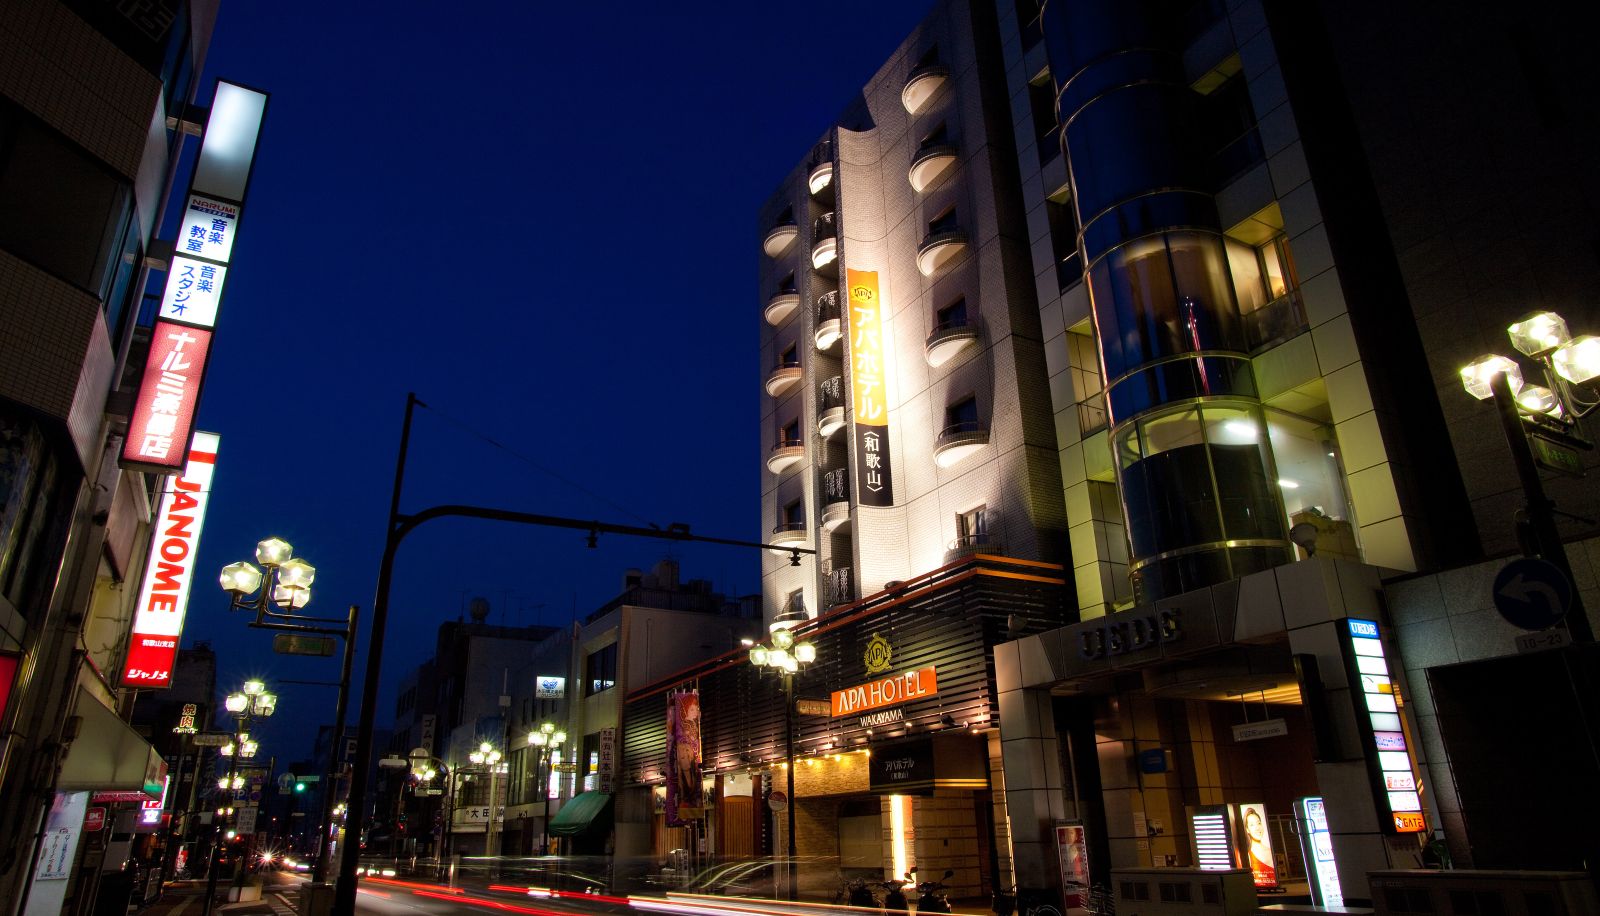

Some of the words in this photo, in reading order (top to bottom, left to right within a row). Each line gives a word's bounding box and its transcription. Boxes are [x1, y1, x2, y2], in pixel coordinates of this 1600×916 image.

[191, 199, 236, 214] NARUMI
[186, 225, 207, 253] 教室
[207, 218, 228, 245] 音楽
[171, 265, 195, 316] スタジオ
[197, 265, 216, 293] 音楽
[853, 307, 882, 420] アパホテル
[147, 475, 202, 613] JANOME
[127, 668, 169, 681] ジャノメ
[838, 687, 868, 713] APA
[871, 672, 926, 704] HOTEL
[180, 703, 196, 727] 焼肉
[860, 709, 904, 727] WAKAYAMA
[1403, 817, 1423, 828] GATE
